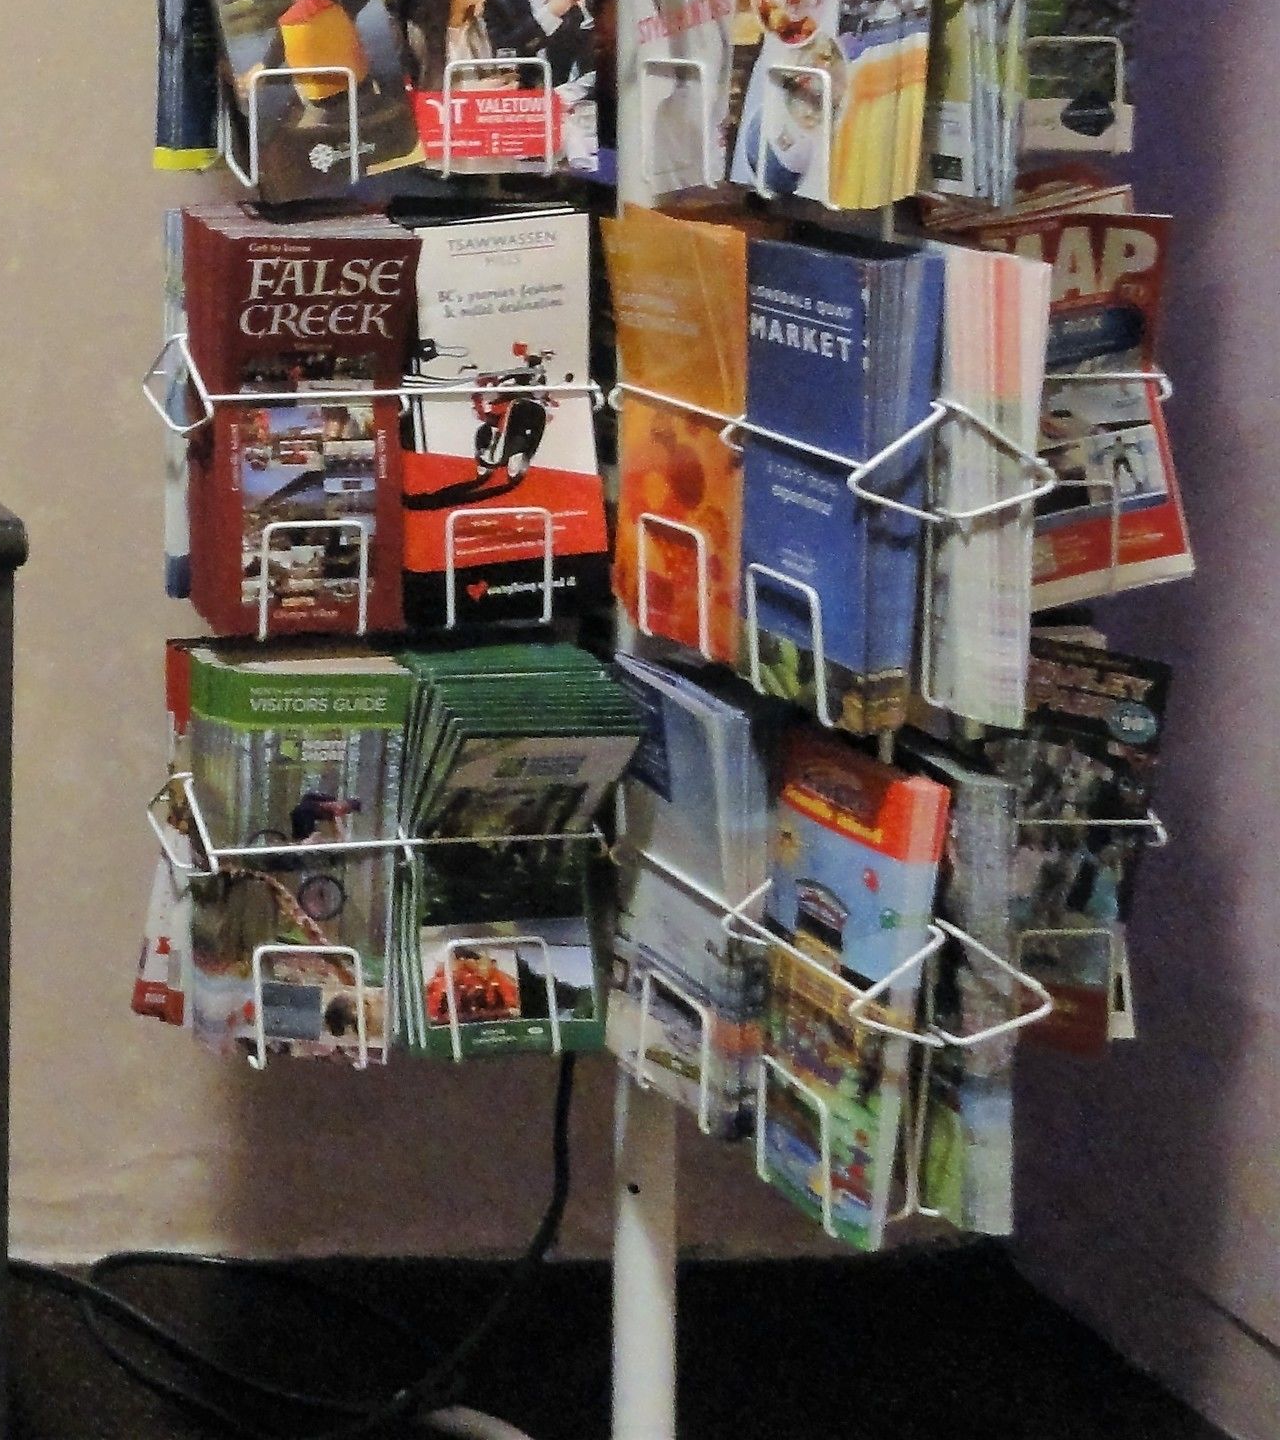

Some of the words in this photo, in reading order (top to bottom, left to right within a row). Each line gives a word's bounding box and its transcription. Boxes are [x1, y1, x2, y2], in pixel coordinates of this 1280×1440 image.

[243, 256, 405, 303] FALSE
[239, 301, 393, 339] CREEK
[749, 312, 852, 363] MARKET
[249, 697, 329, 712] VISITORS
[332, 697, 388, 712] GUIDE
